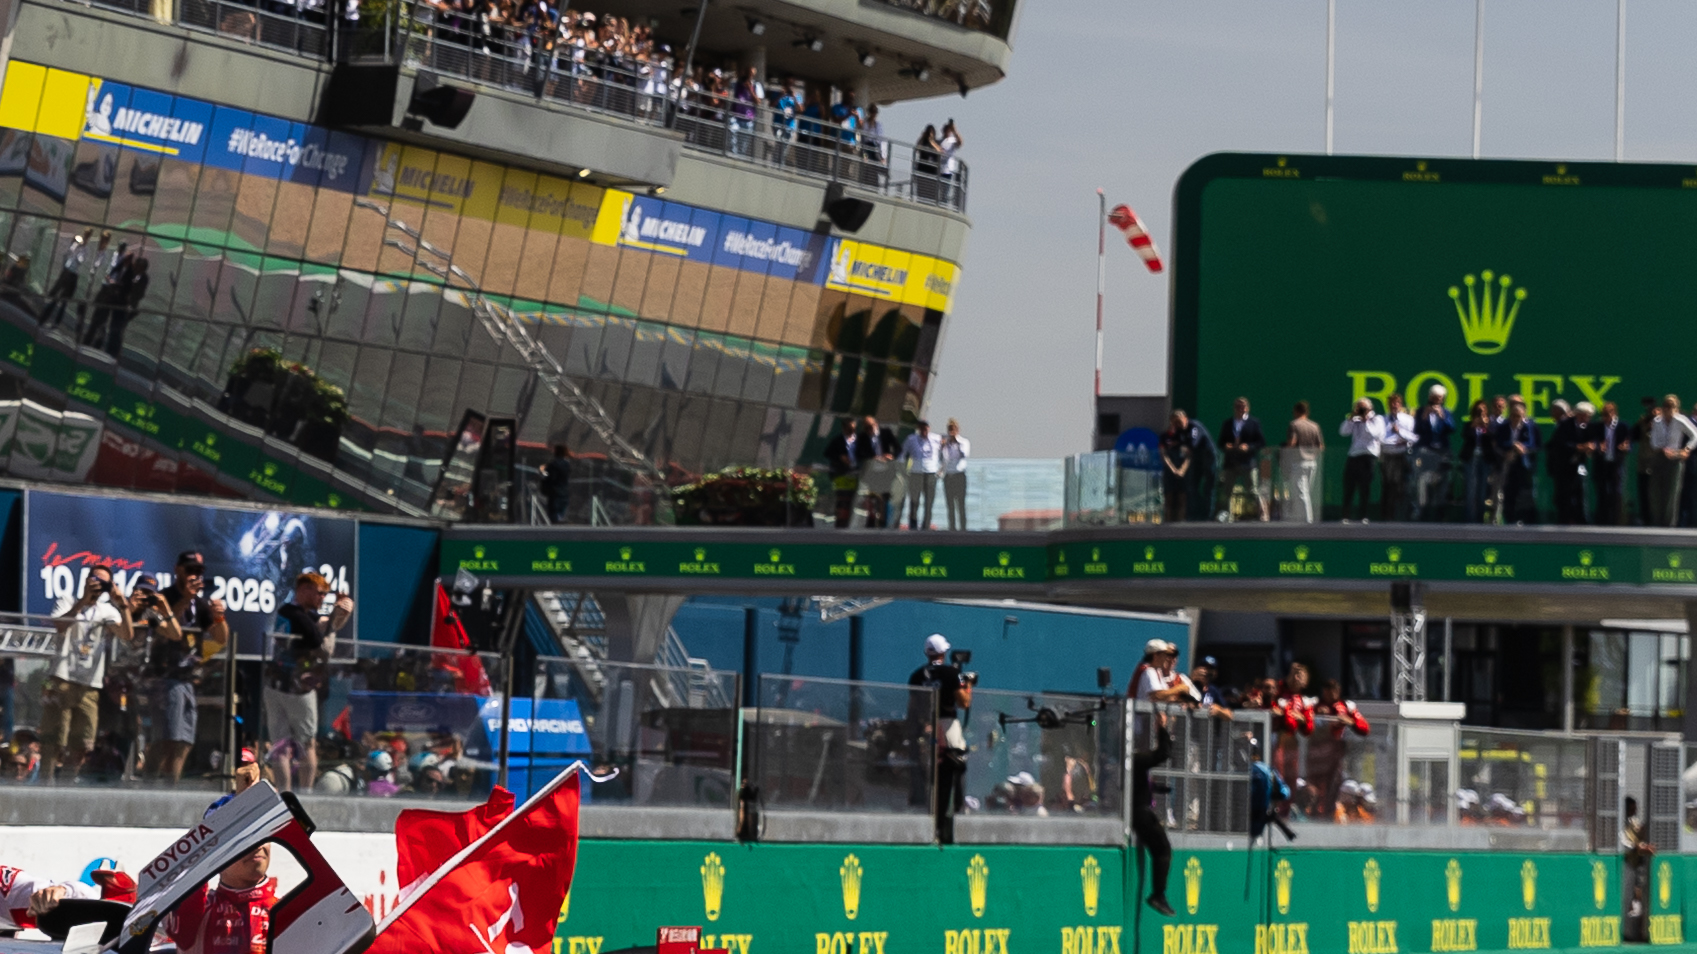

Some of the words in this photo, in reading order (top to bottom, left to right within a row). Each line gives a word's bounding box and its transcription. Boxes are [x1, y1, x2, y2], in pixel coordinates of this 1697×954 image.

[113, 107, 204, 145] MICHELIN
[399, 166, 475, 199] MICHELIN
[640, 216, 707, 248] MICHELIN
[851, 260, 909, 286] MICHELIN
[532, 560, 572, 572] ROLEX
[605, 561, 645, 573] ROLEX
[679, 562, 720, 574] ROLEX
[754, 563, 795, 575] ROLEX
[829, 564, 871, 576] ROLEX
[906, 566, 947, 577] ROLEX
[982, 567, 1025, 578] ROLEX
[1133, 562, 1165, 573] ROLEX
[1199, 562, 1238, 574] ROLEX
[1279, 562, 1323, 574] ROLEX
[1369, 562, 1418, 576] ROLEX
[1465, 564, 1515, 578] ROLEX
[1561, 566, 1609, 579] ROLEX
[1652, 568, 1696, 580] ROLEX
[210, 576, 276, 613] 2026
[142, 823, 214, 880] TOYOTA
[1348, 921, 1398, 954] ROLEX
[1431, 919, 1477, 951] ROLEX
[1508, 917, 1551, 949] ROLEX
[1580, 916, 1620, 946] ROLEX
